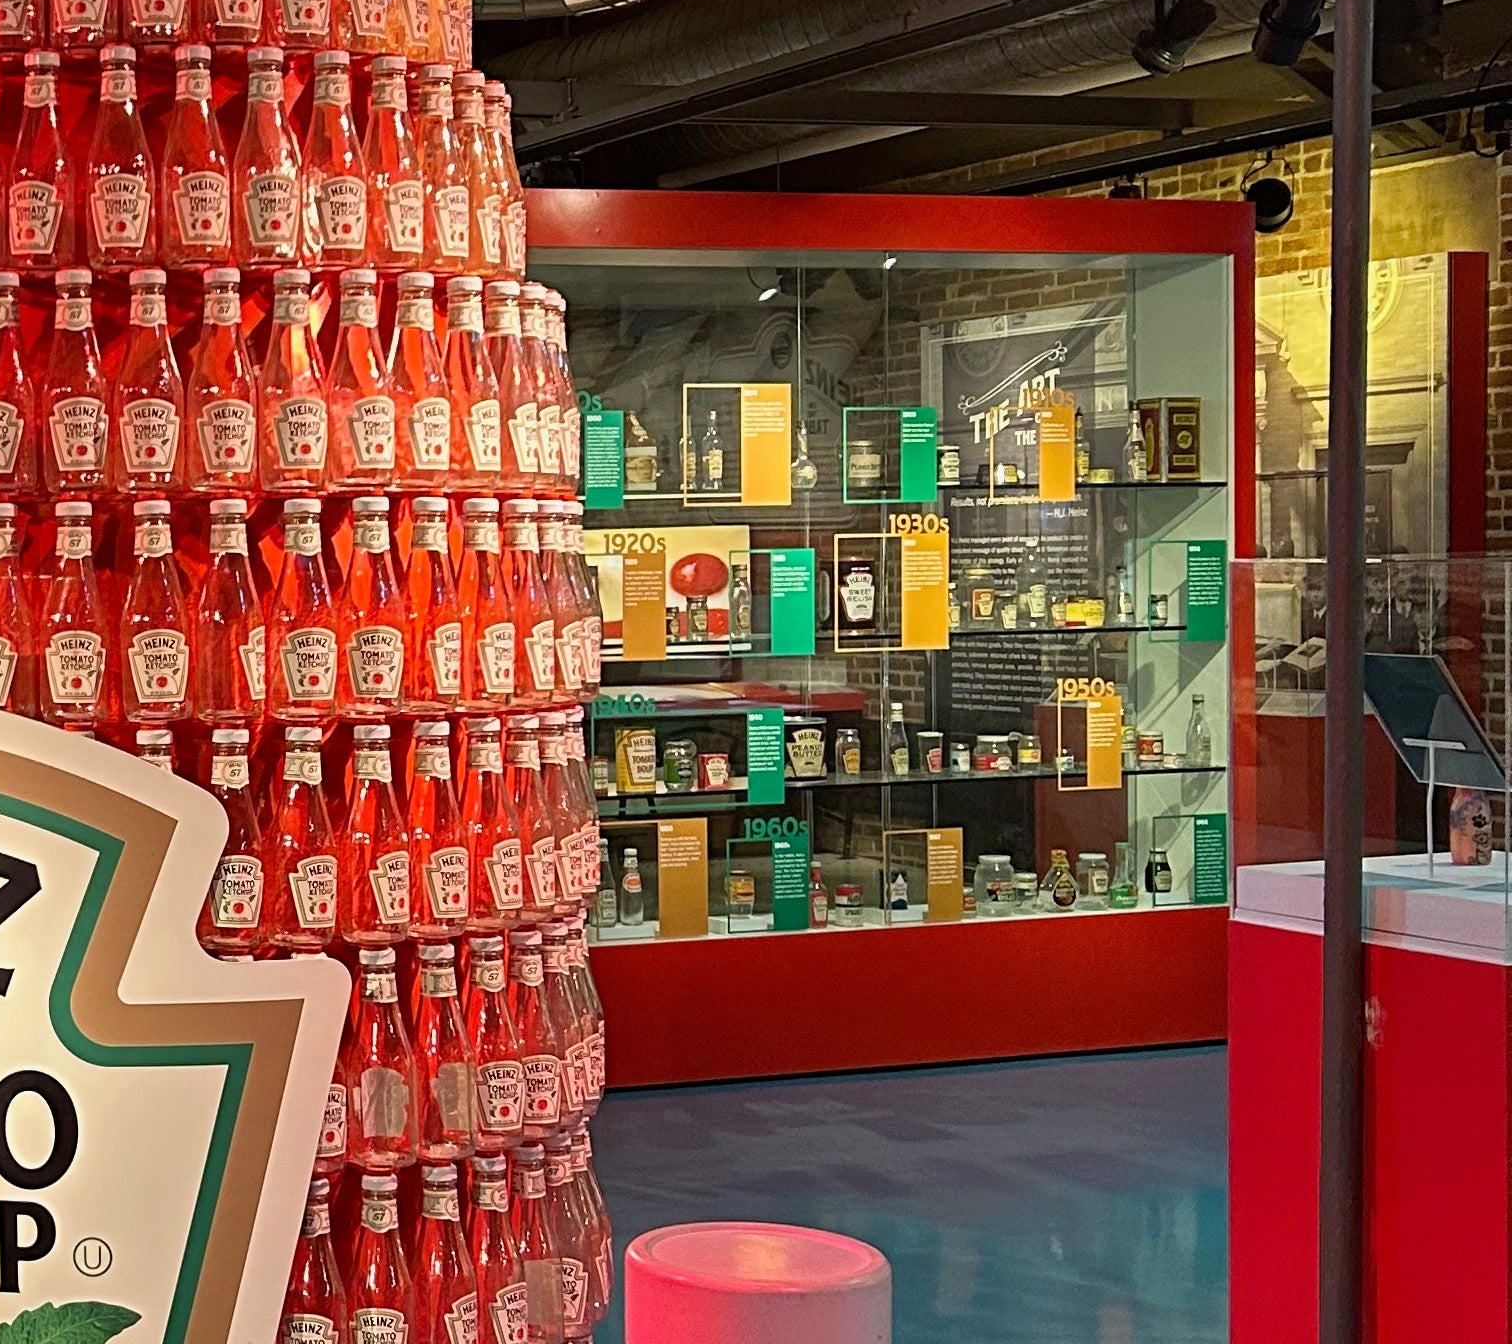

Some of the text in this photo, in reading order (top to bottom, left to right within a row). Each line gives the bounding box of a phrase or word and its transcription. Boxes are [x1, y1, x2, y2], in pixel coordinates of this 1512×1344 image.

[105, 182, 136, 194] HEINZ
[134, 407, 166, 420] HEINZ
[213, 407, 244, 420] HEINZ
[969, 399, 1011, 444] THE
[1014, 429, 1037, 446] THE
[889, 513, 950, 534] 1930s
[603, 532, 666, 554] 1920s
[60, 639, 92, 653] HEINZ
[143, 638, 176, 651] HEINZ
[296, 637, 328, 650] HEINZ
[1057, 677, 1116, 698] 1950s
[798, 732, 820, 741] HEINZ
[744, 816, 809, 839] 1960s
[222, 863, 254, 876] HEINZ
[291, 1322, 323, 1335] HEINZ
[362, 1316, 394, 1329] HEINZ
